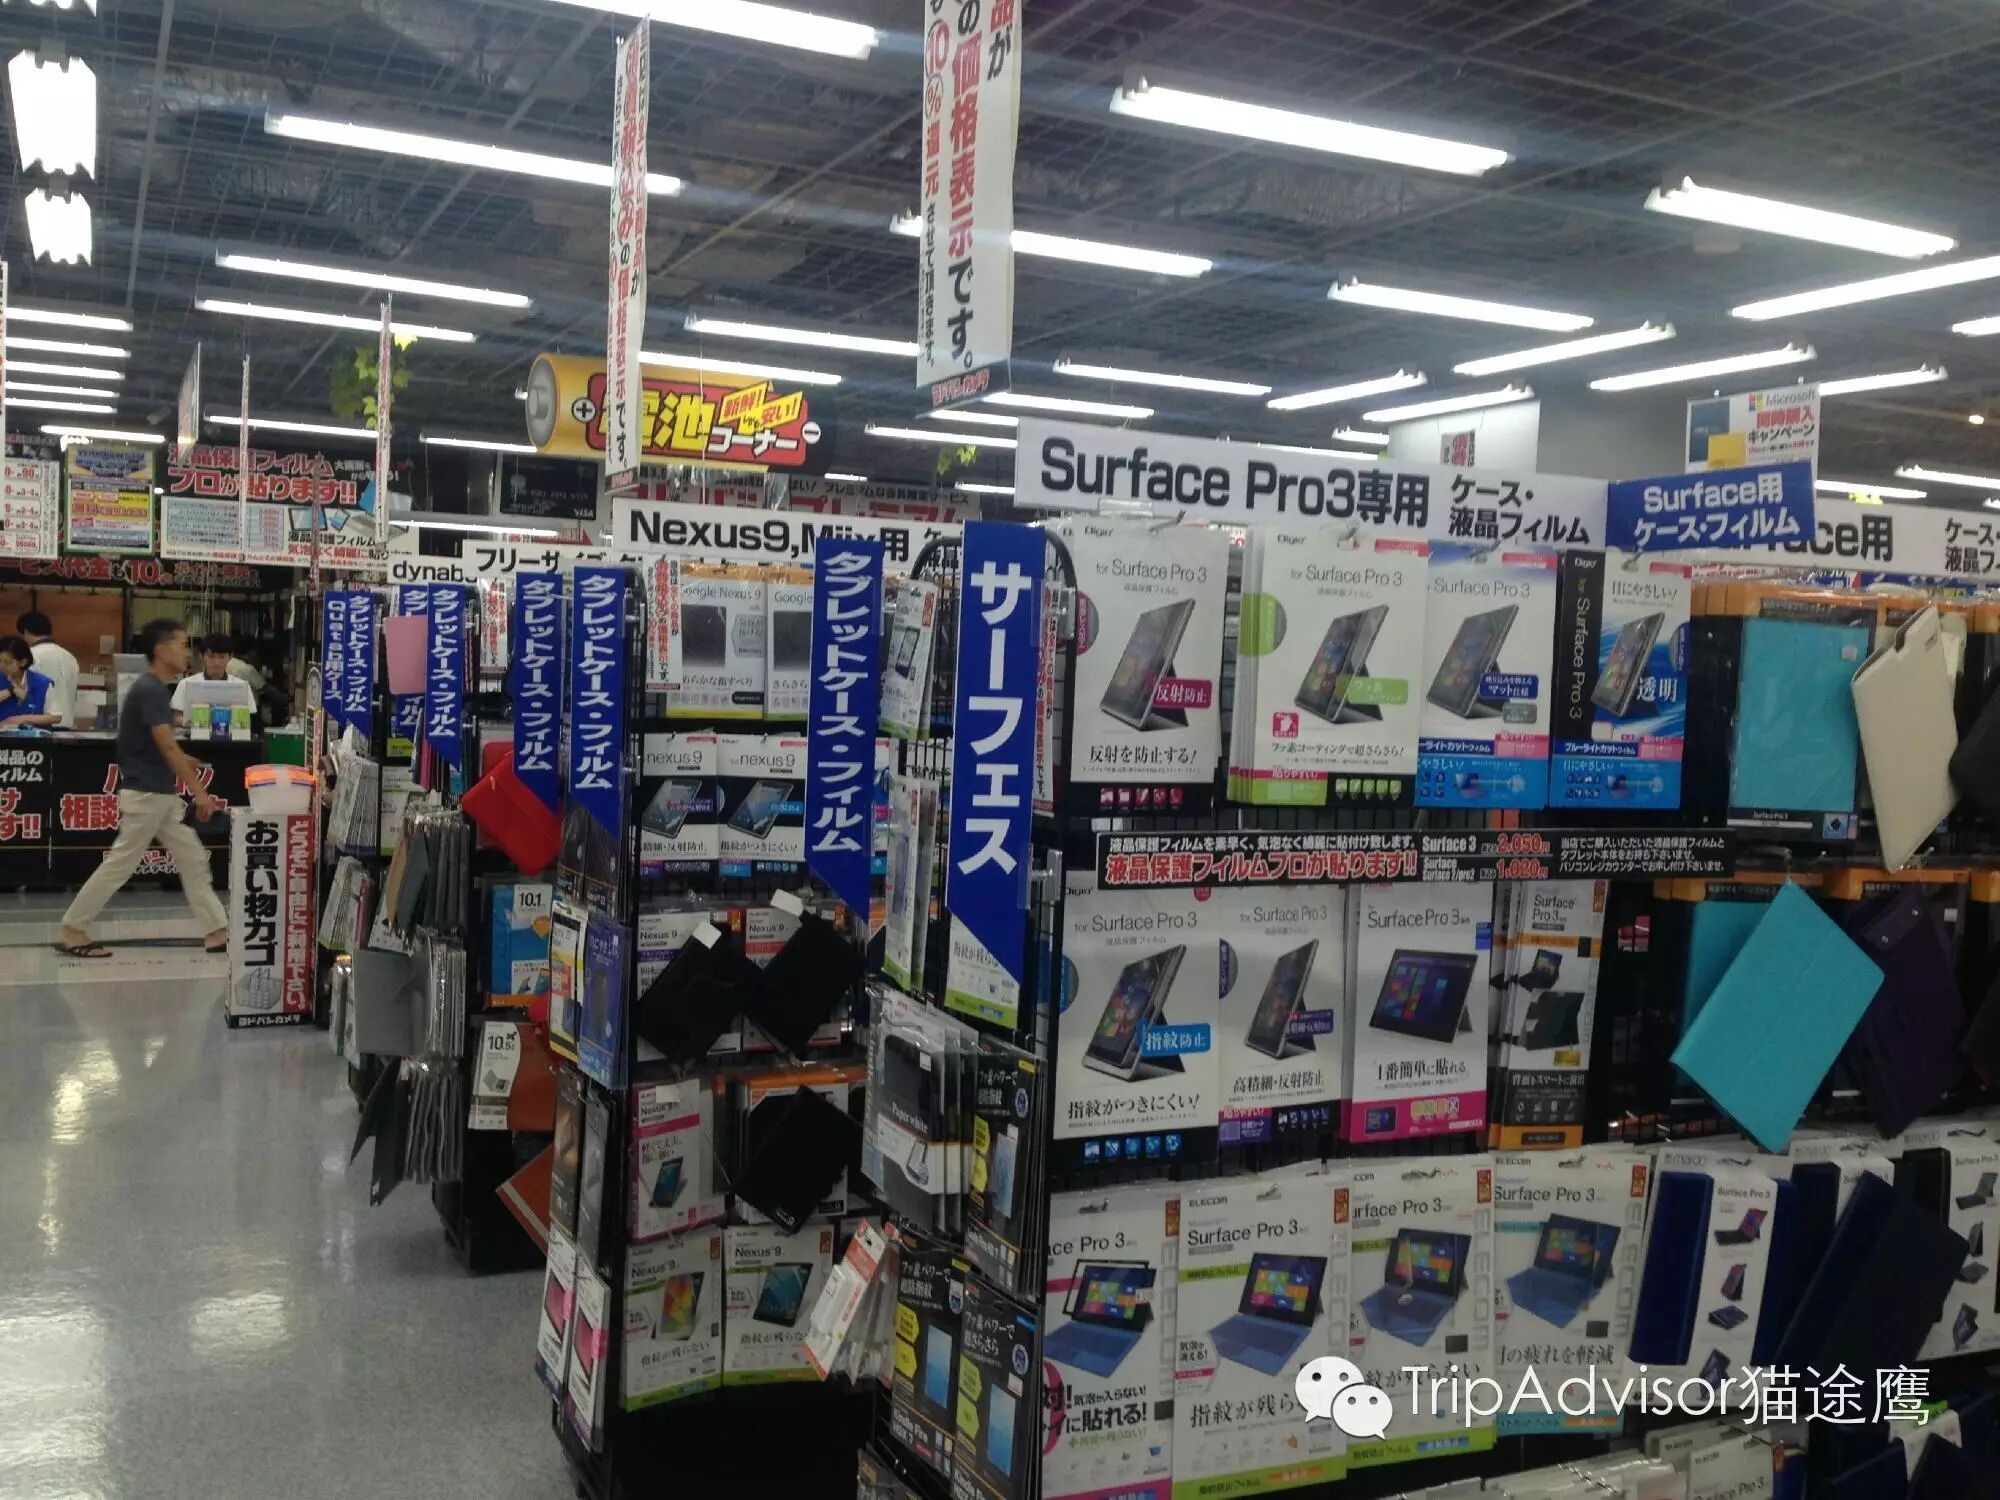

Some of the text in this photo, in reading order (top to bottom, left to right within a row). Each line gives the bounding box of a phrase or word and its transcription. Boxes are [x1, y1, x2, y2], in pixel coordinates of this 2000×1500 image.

[1749, 424, 1815, 443] キャンペーン
[1042, 437, 1430, 528] Surface Pro3専用
[1451, 474, 1534, 504] ケース・
[1644, 472, 1783, 513] Surface用
[1449, 512, 1591, 546] 液晶フィルム
[1634, 506, 1800, 547] ケース・フィルム
[1112, 559, 1168, 580] Surface
[1170, 563, 1195, 583] Pro
[1197, 568, 1207, 583] 3
[1305, 564, 1361, 584] Surface
[1364, 566, 1389, 586] Pro
[1392, 567, 1403, 586] 3
[720, 587, 762, 600] Nexus 9
[1434, 577, 1530, 597] Surface Pro 3
[1612, 580, 1678, 600] 目にやさしい!
[345, 595, 370, 712] タブレットケース・フィルム
[429, 588, 459, 737] タブレットケース・フィルム
[1570, 597, 1591, 720] Surface Pro 3
[518, 579, 555, 771] タブレットケース・フィルム
[574, 574, 616, 790] タブレットケース・フィルム
[1156, 681, 1207, 704] 反射防止
[1488, 684, 1529, 698] マット仕様
[1637, 676, 1678, 703] 透明
[811, 551, 872, 852] タブレットケース・フィルム
[957, 560, 1033, 876] サーフェス
[647, 750, 703, 765] nexus 9
[1089, 746, 1199, 765] 反射を防止する!
[1564, 742, 1636, 755] ブルーライトカットフィルム
[740, 753, 796, 768] nexus 9
[1422, 835, 1467, 853] Surface
[1468, 835, 1477, 852] 3
[1106, 850, 1418, 884] 液晶保護フィルムプロが貼ります!!
[1422, 857, 1457, 869] Surface
[1422, 868, 1451, 881] Surface
[244, 820, 279, 967] お買い物カゴ
[518, 891, 543, 907] 10.1
[1533, 894, 1575, 910] Surface
[1074, 911, 1198, 933] for Surface Pro 3
[1253, 906, 1299, 923] Surface
[1301, 906, 1318, 921] Pro
[1320, 905, 1328, 921] 3
[1368, 908, 1460, 929] Surface Pro 3
[1532, 908, 1560, 922] Pro 3
[640, 929, 678, 940] Nexus 9
[749, 922, 785, 933] Nexus 9
[1145, 1030, 1206, 1051] 指紋防止
[1232, 1069, 1325, 1094] 高精細・反射防止
[1067, 1093, 1201, 1120] 指紋がつきにくい!
[1556, 1187, 1582, 1201] Pro
[1585, 1186, 1596, 1201] 3
[1717, 1186, 1771, 1199] Surface Pro 3
[1402, 1198, 1428, 1215] Pro
[1432, 1196, 1442, 1213] 3
[1080, 1232, 1125, 1252] Pro 3
[1187, 1218, 1299, 1247] Surface Pro 3
[734, 1246, 782, 1258] Nexus 9
[631, 1259, 677, 1279] Nexus 9
[1190, 1392, 1303, 1429] 指紋が残ら
